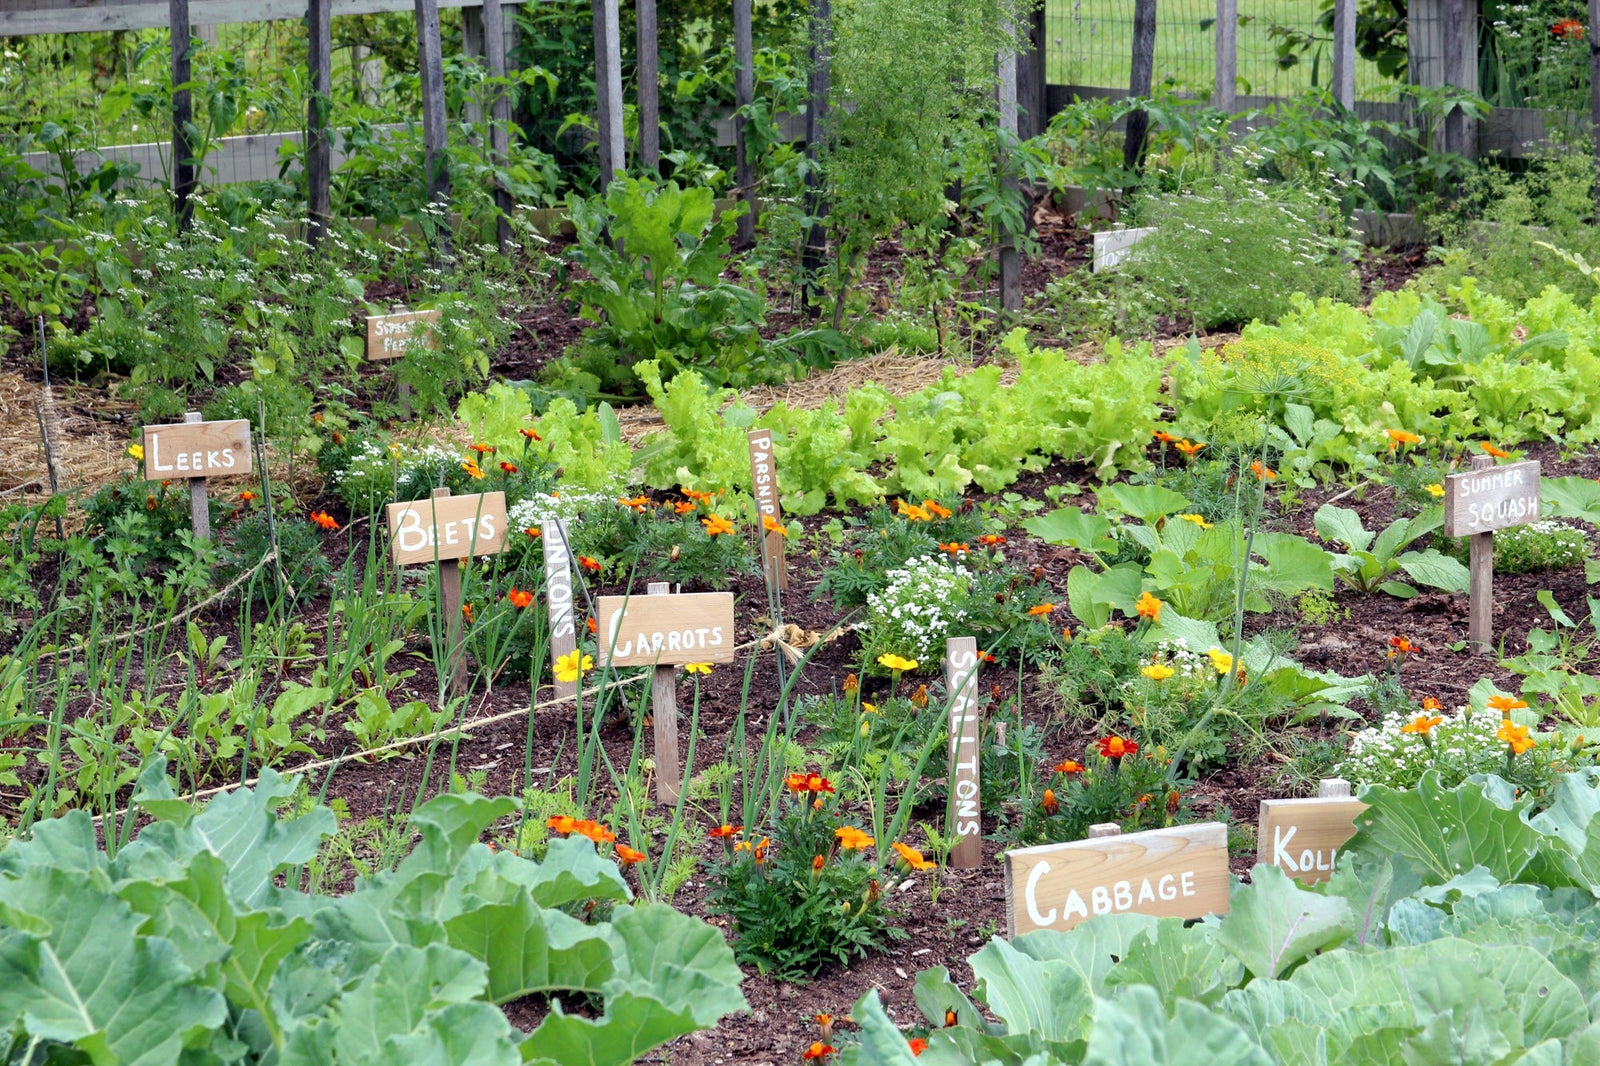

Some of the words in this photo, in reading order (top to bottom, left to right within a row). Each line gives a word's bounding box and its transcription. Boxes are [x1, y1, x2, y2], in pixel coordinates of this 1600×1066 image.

[152, 433, 235, 471] LEEKS
[751, 437, 777, 522] PARSNIP
[1460, 469, 1523, 497] SUMMER
[397, 509, 495, 551] BEETS
[1468, 496, 1538, 527] SQUASH
[545, 527, 575, 638] ONIONS
[608, 607, 723, 657] CARROTS
[950, 650, 979, 836] SCALLIONS
[1025, 860, 1196, 926] CABBAGE
